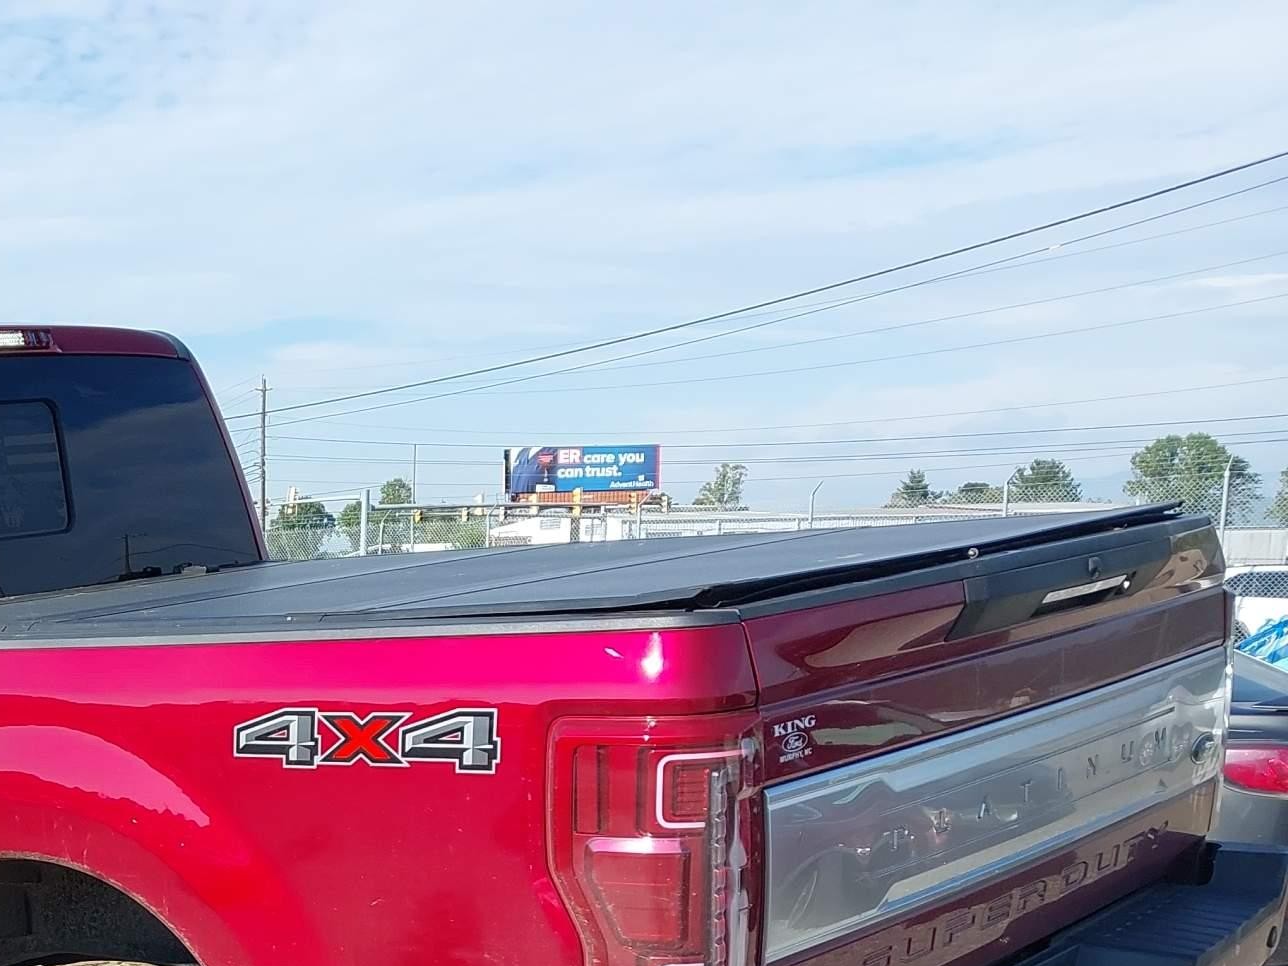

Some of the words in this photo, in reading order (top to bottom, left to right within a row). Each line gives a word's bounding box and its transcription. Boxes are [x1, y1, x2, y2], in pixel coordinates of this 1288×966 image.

[558, 449, 581, 464] ER
[584, 453, 615, 463] care
[618, 452, 645, 466] you
[557, 468, 583, 478] can
[585, 465, 622, 477] trust.
[610, 480, 654, 489] AdventHealth
[772, 714, 817, 738] KING
[882, 727, 1169, 852] PLATINUM
[1062, 820, 1168, 887] DUTY
